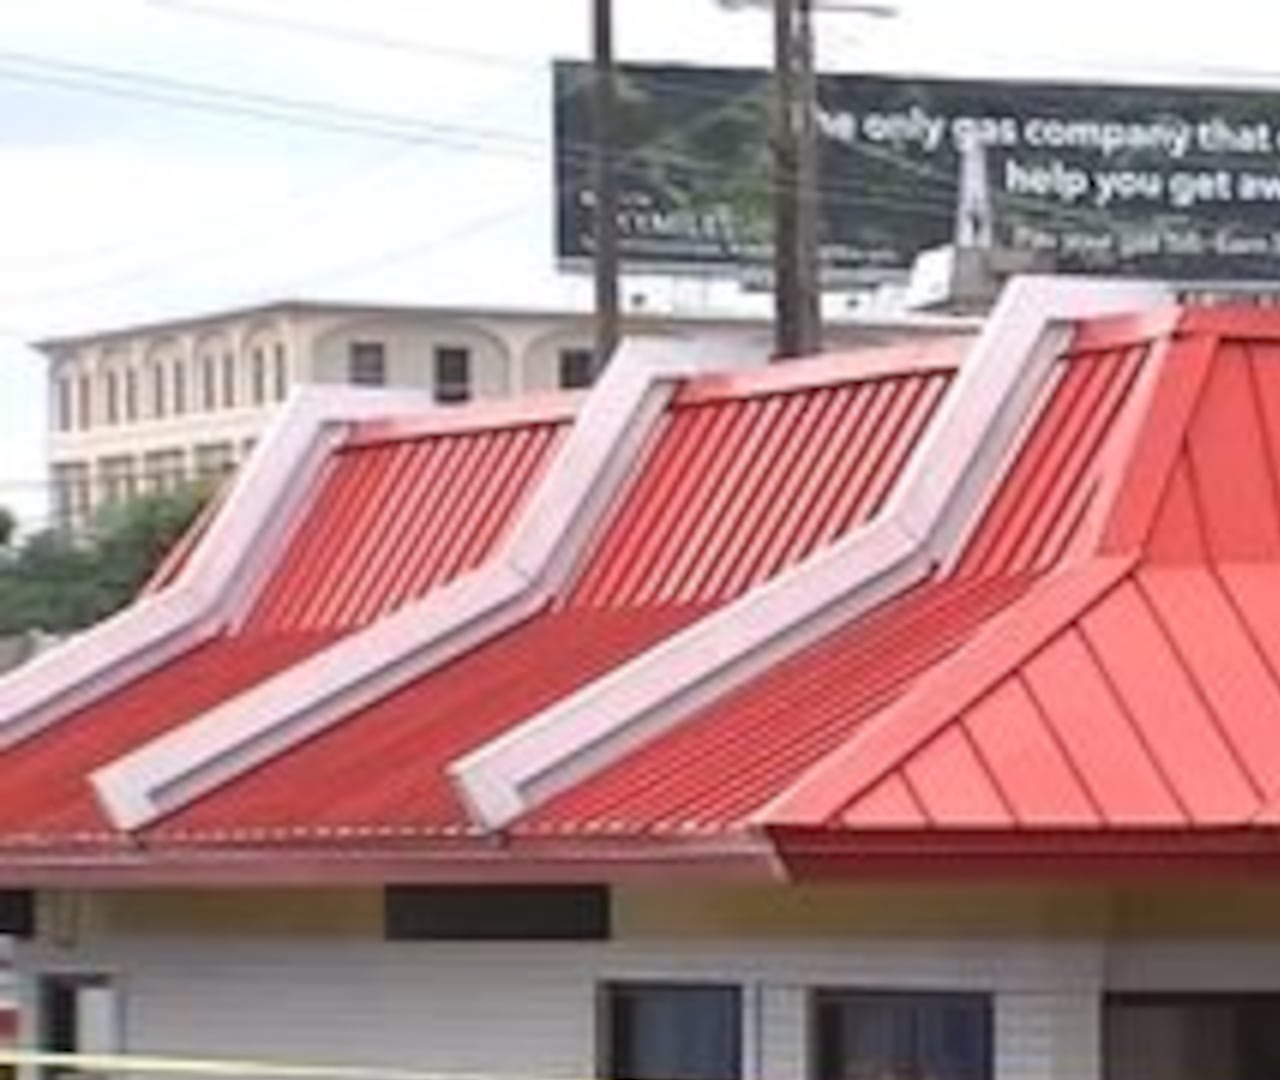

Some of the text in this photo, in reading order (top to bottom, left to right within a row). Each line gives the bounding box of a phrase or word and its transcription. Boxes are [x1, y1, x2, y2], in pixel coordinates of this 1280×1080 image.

[862, 105, 945, 151] only
[952, 116, 1017, 151] gas
[1023, 116, 1191, 158] company
[1197, 119, 1272, 153] that
[1005, 158, 1089, 201] help
[1094, 171, 1162, 207] you
[1167, 171, 1232, 207] get
